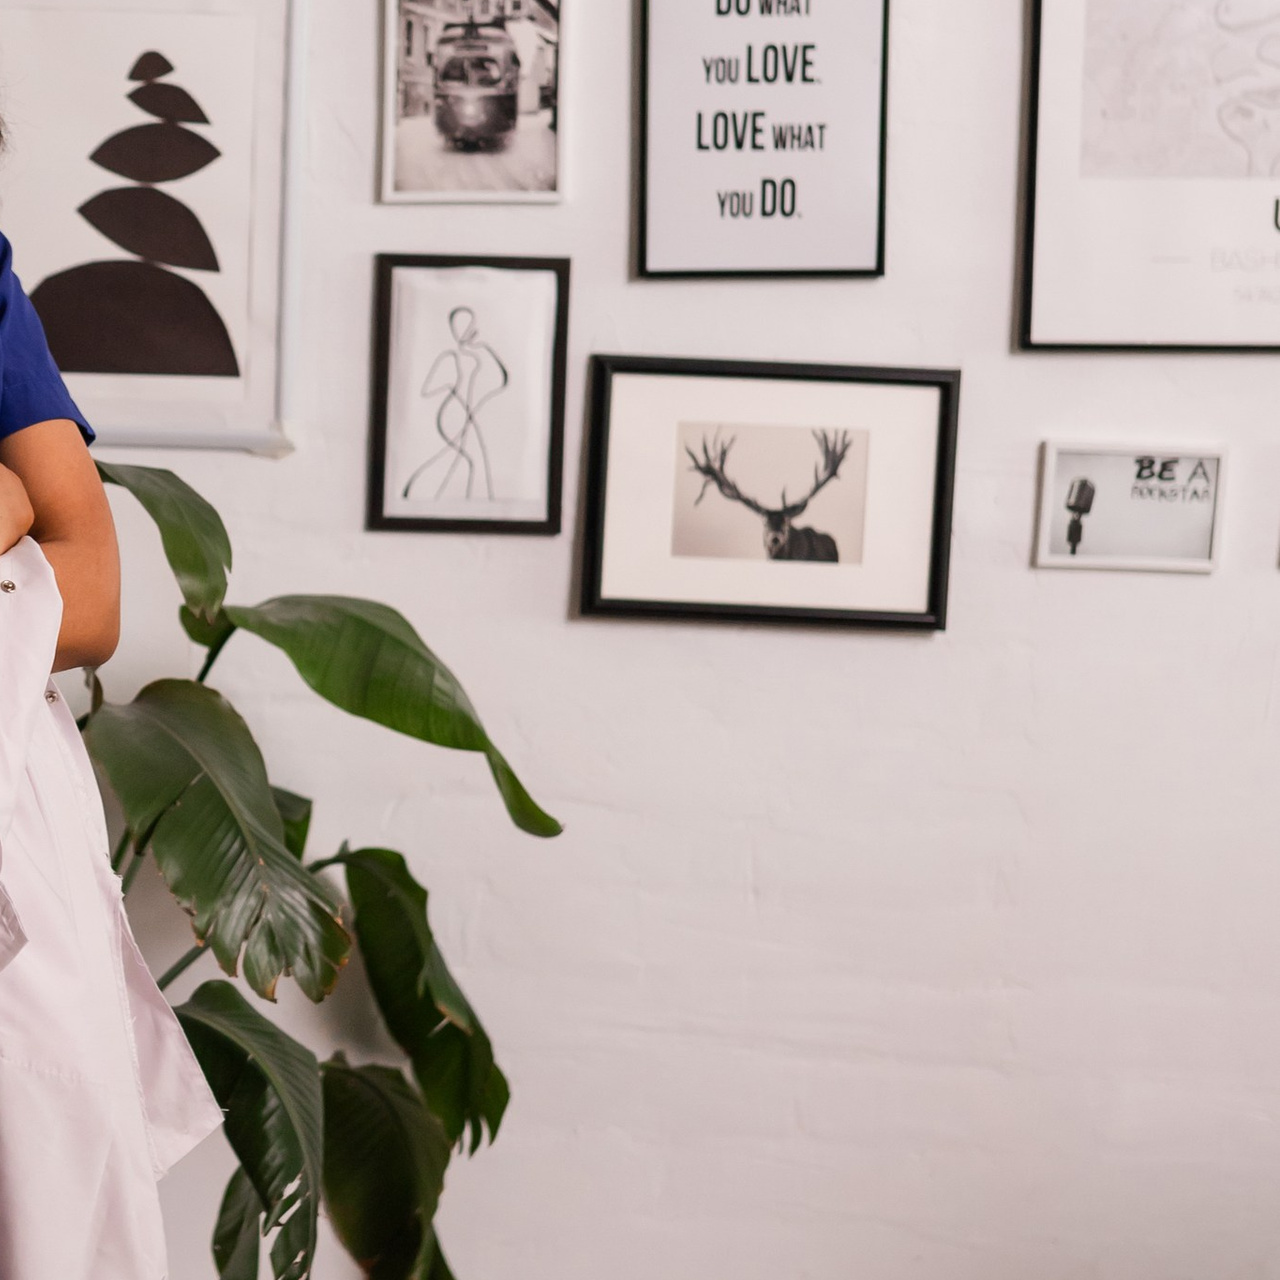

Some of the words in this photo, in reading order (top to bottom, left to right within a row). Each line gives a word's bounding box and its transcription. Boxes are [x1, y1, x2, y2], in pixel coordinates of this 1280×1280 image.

[702, 57, 740, 84] YOU
[696, 112, 766, 150] LOVE
[772, 123, 826, 150] WHAT
[718, 191, 753, 218] YOU
[1134, 455, 1180, 482] BE
[1187, 458, 1211, 484] A
